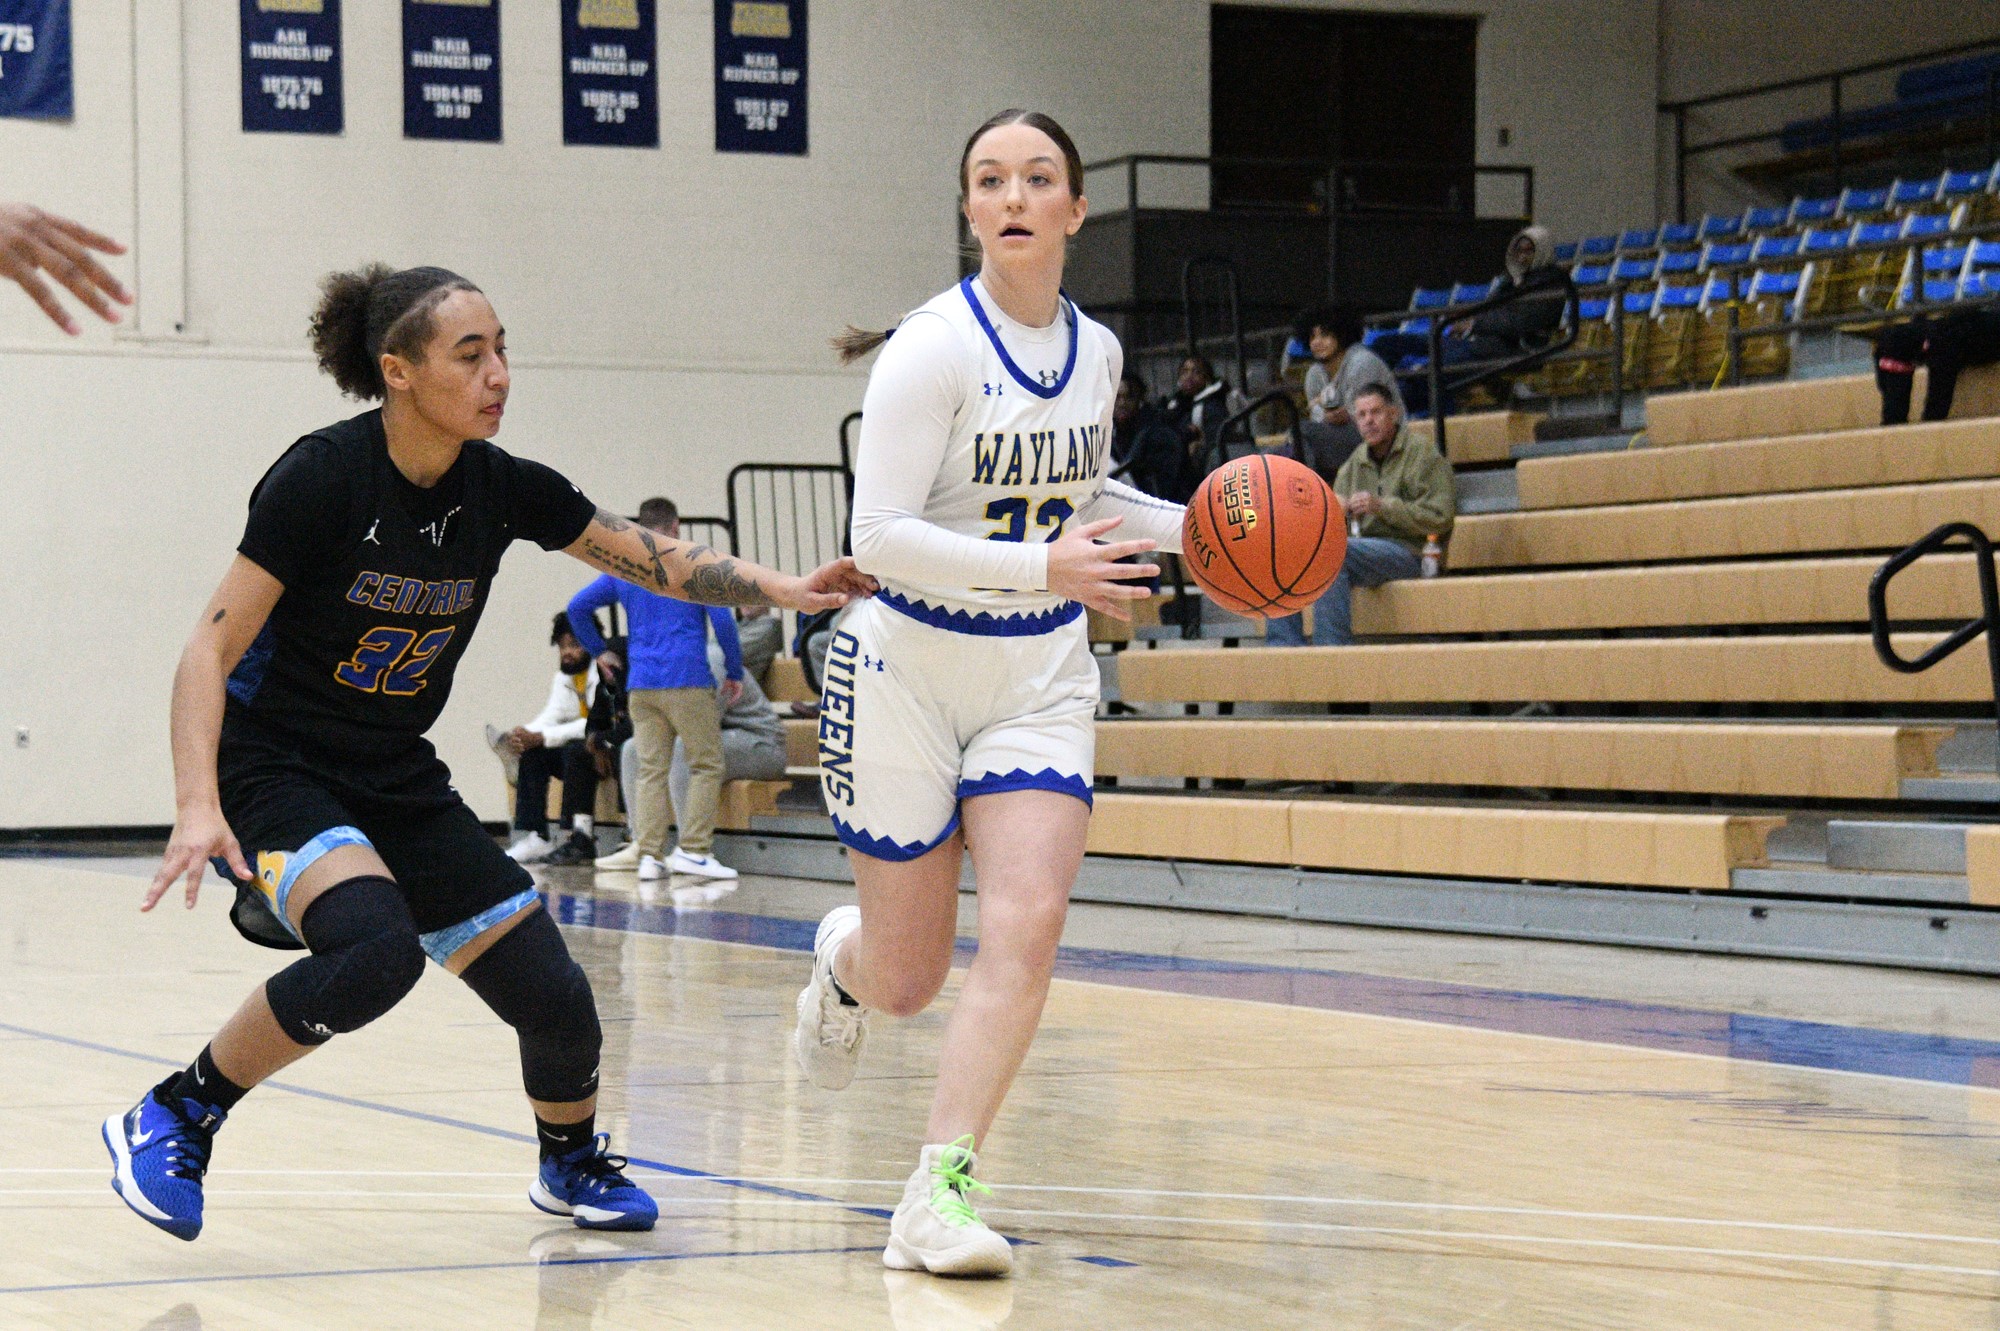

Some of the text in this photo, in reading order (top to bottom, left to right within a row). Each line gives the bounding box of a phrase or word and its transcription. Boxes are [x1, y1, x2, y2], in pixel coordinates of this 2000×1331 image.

[249, 42, 333, 61] RUNNER UP
[411, 51, 493, 70] RUNNER UP
[569, 58, 649, 76] RUNNER UP
[723, 66, 799, 85] RUNNER UP
[334, 626, 455, 695] 32
[820, 629, 860, 807] QUEENS
